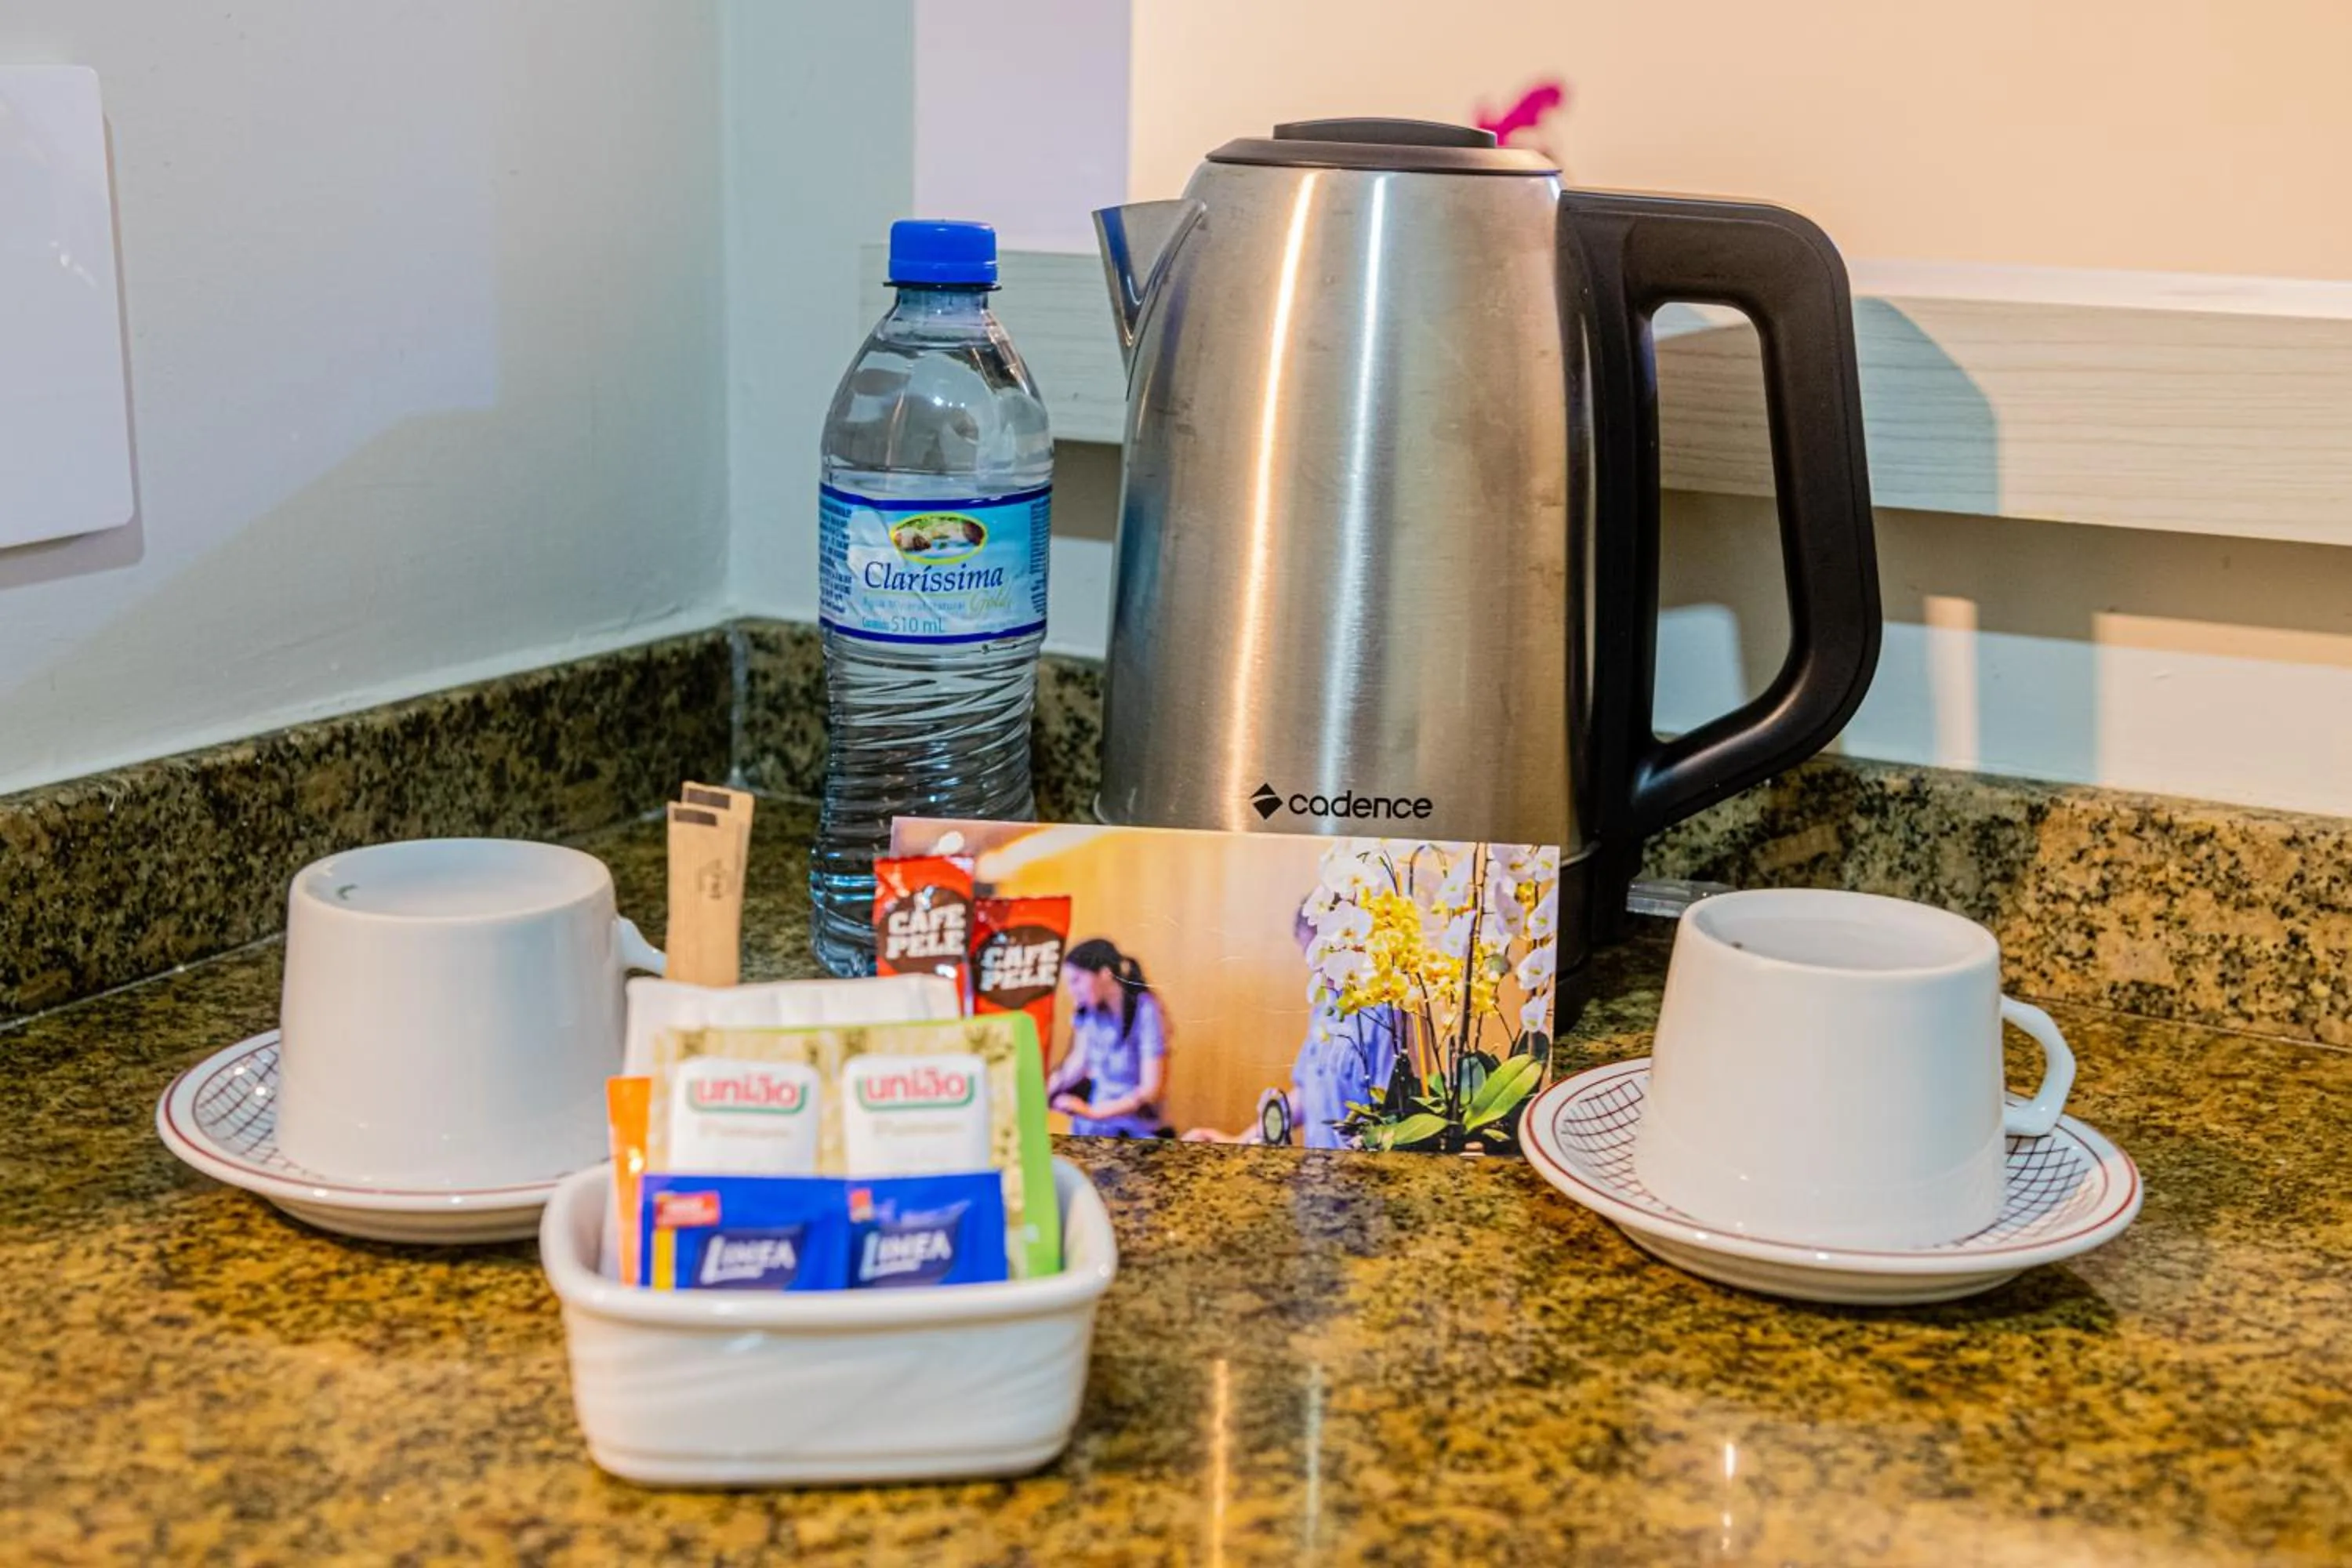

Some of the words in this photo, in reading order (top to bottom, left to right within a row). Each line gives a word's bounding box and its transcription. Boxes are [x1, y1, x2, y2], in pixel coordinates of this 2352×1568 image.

[865, 561, 1004, 593] Claríssima
[891, 616, 918, 633] 510
[1288, 789, 1433, 818] cadence
